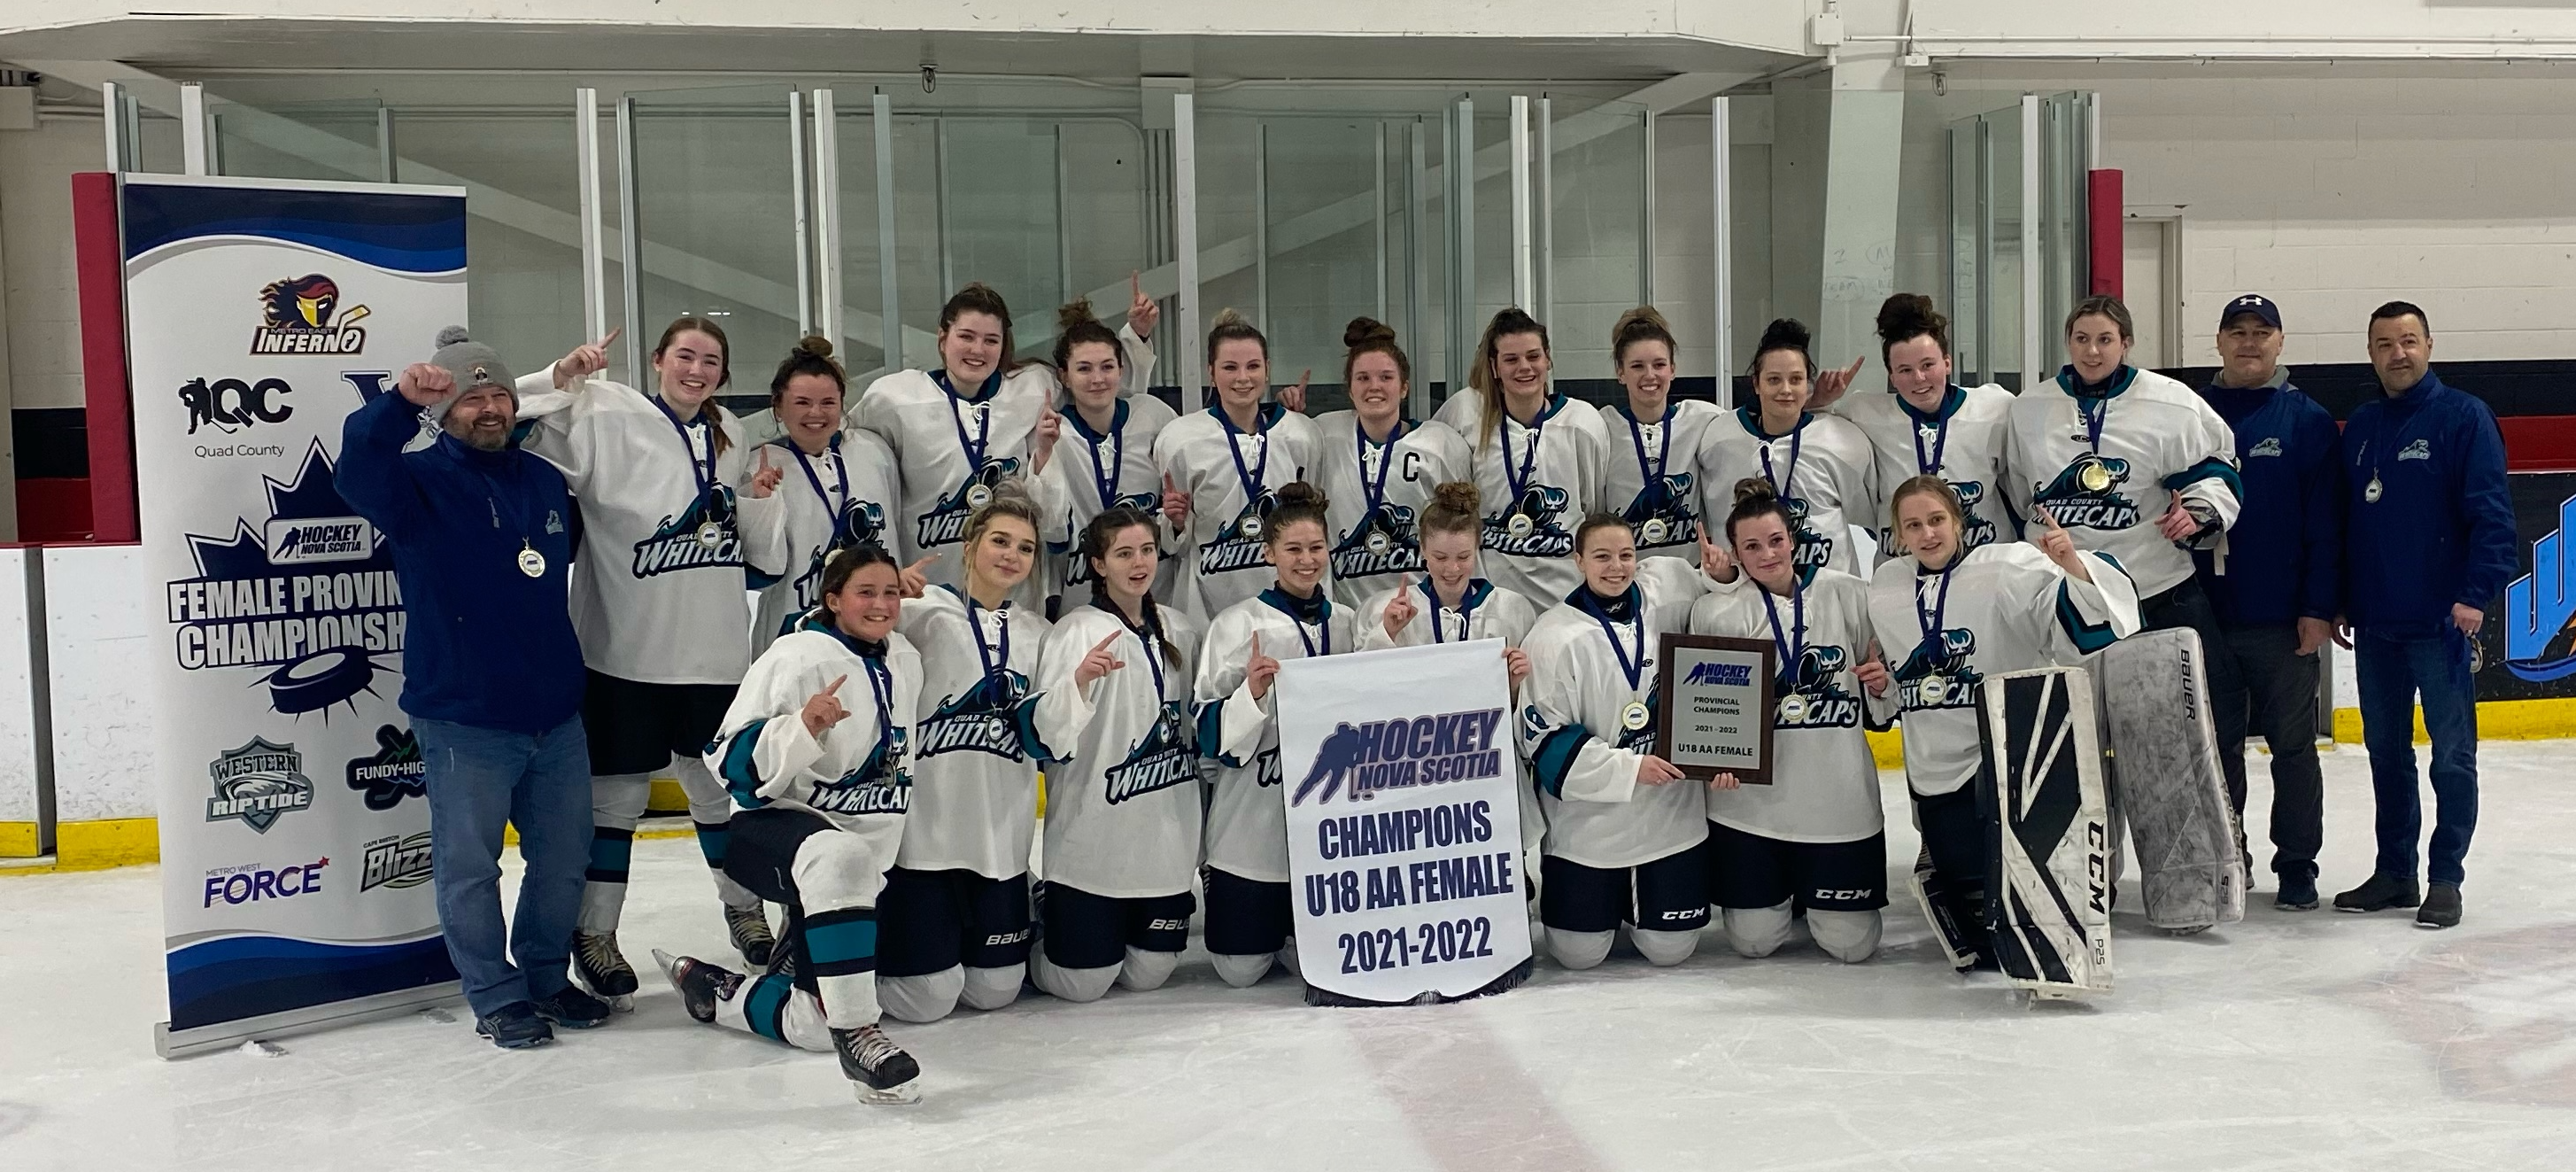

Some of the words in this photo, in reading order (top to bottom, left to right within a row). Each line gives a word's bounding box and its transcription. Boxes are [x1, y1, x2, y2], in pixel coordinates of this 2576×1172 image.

[256, 328, 361, 353] INFERNO
[194, 445, 233, 458] Quad
[236, 444, 285, 457] County
[1403, 452, 1420, 482] C
[300, 524, 364, 543] HOCKEY
[301, 542, 325, 555] NOVA
[327, 541, 361, 554] SCOTIA
[169, 577, 288, 622] FEMALE
[1704, 663, 1752, 679] HOCKEY
[1693, 696, 1740, 706] PROVINCIAL
[1693, 706, 1740, 716] CHAMPIONS
[1356, 710, 1503, 765] HOCKEY
[1678, 742, 1698, 754] U18
[1698, 744, 1713, 754] AA
[1714, 746, 1753, 757] FEMALE
[215, 754, 298, 780] WESTERN
[1357, 759, 1417, 791] NOVA
[1420, 750, 1499, 783] SCOTIA
[212, 790, 309, 817] RIPTIDE
[1318, 800, 1493, 860] CHAMPIONS
[205, 865, 236, 877] METRO
[237, 862, 262, 873] WEST
[2088, 820, 2106, 915] CCM
[204, 863, 322, 909] FORCE
[1304, 870, 1361, 918] U18
[1365, 865, 1407, 911] AA
[1410, 851, 1514, 905] FEMALE
[1815, 889, 1872, 900] CCM
[1662, 907, 1705, 920] CCM
[1337, 916, 1494, 974] 2021-2022
